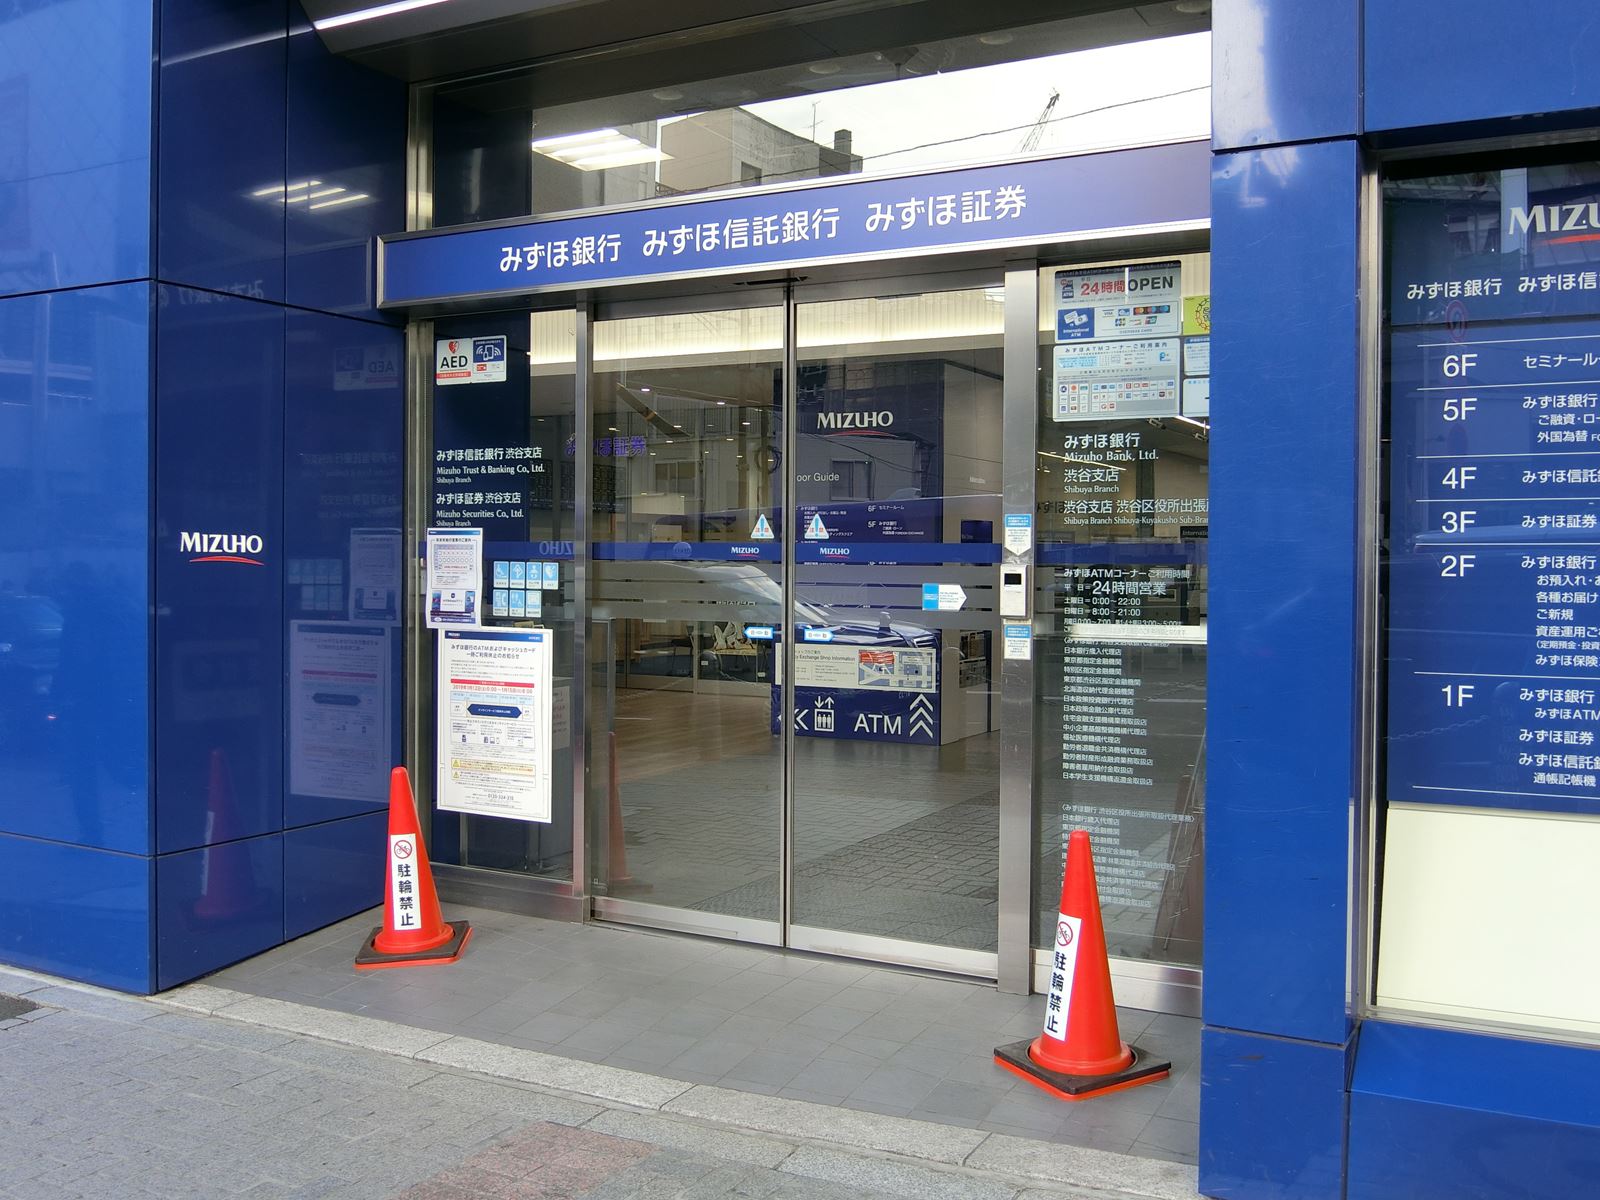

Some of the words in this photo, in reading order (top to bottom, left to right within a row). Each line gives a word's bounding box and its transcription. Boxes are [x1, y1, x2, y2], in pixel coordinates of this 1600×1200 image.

[500, 233, 621, 273] みずほ銀行
[643, 207, 840, 257] みずほ信託銀行
[865, 184, 1027, 232] みずほ証券
[1080, 279, 1126, 297] 24時間
[1128, 275, 1174, 292] OPEN
[1407, 278, 1502, 299] みずほ銀行
[1518, 271, 1600, 293] みずほ信
[440, 355, 468, 369] AED
[1443, 353, 1478, 378] 6F
[1523, 352, 1600, 369] セミナール
[1522, 393, 1598, 409] みずほ銀行
[1443, 398, 1478, 421] 5F
[817, 410, 894, 429] MIZUHO
[1064, 432, 1141, 449] みずほ銀行
[1537, 430, 1588, 443] 外国為替
[436, 447, 504, 461] みずほ信託銀行
[505, 446, 543, 460] 渋谷支店
[1064, 450, 1103, 462] Mizuho
[1106, 450, 1136, 462] Bank,
[1139, 449, 1159, 460] Ltd.
[436, 466, 461, 475] Mizuho
[462, 465, 479, 474] Trust
[481, 465, 487, 474] &
[487, 464, 515, 475] Banking
[531, 463, 545, 473] Ltd.
[796, 473, 811, 482] oor
[813, 472, 840, 482] Guide
[1064, 468, 1119, 483] 渋谷支店
[1522, 469, 1600, 483] みずほ信託
[1442, 466, 1477, 490] 4F
[436, 492, 484, 505] みずほ証券
[485, 491, 521, 504] 渋谷支店
[1064, 485, 1092, 495] Shibuya
[1094, 485, 1119, 493] Branch
[436, 509, 461, 518] Mizuho
[462, 509, 495, 518] Securities
[511, 508, 524, 517] Ltd.
[1063, 499, 1113, 514] 渋谷支店
[1116, 497, 1208, 514] 渋谷区役所出張
[1063, 517, 1089, 527] Shibuya
[1090, 516, 1113, 525] Branch
[1179, 515, 1208, 524] Sub-Bra
[1441, 511, 1477, 534] 3F
[1521, 513, 1597, 529] みずほ証券
[180, 531, 263, 554] MIZUHO
[731, 546, 759, 554] MIZUHO
[819, 547, 850, 555] MIZUHO
[1441, 554, 1476, 577] 2F
[1521, 555, 1597, 570] みずほ銀行
[1535, 591, 1598, 604] 各種お届け
[1536, 608, 1574, 621] ご新規
[1535, 625, 1600, 638] 資産運用ご
[1535, 654, 1600, 668] みずほ保険
[1441, 684, 1475, 707] 1F
[1519, 688, 1595, 705] みずほ銀行
[854, 713, 902, 735] ATM
[1518, 728, 1594, 746] みずほ証券
[1533, 772, 1597, 787] 通帳記帳機
[397, 863, 414, 927] 駐輪禁止
[1047, 950, 1067, 1034] 駐輪禁止
